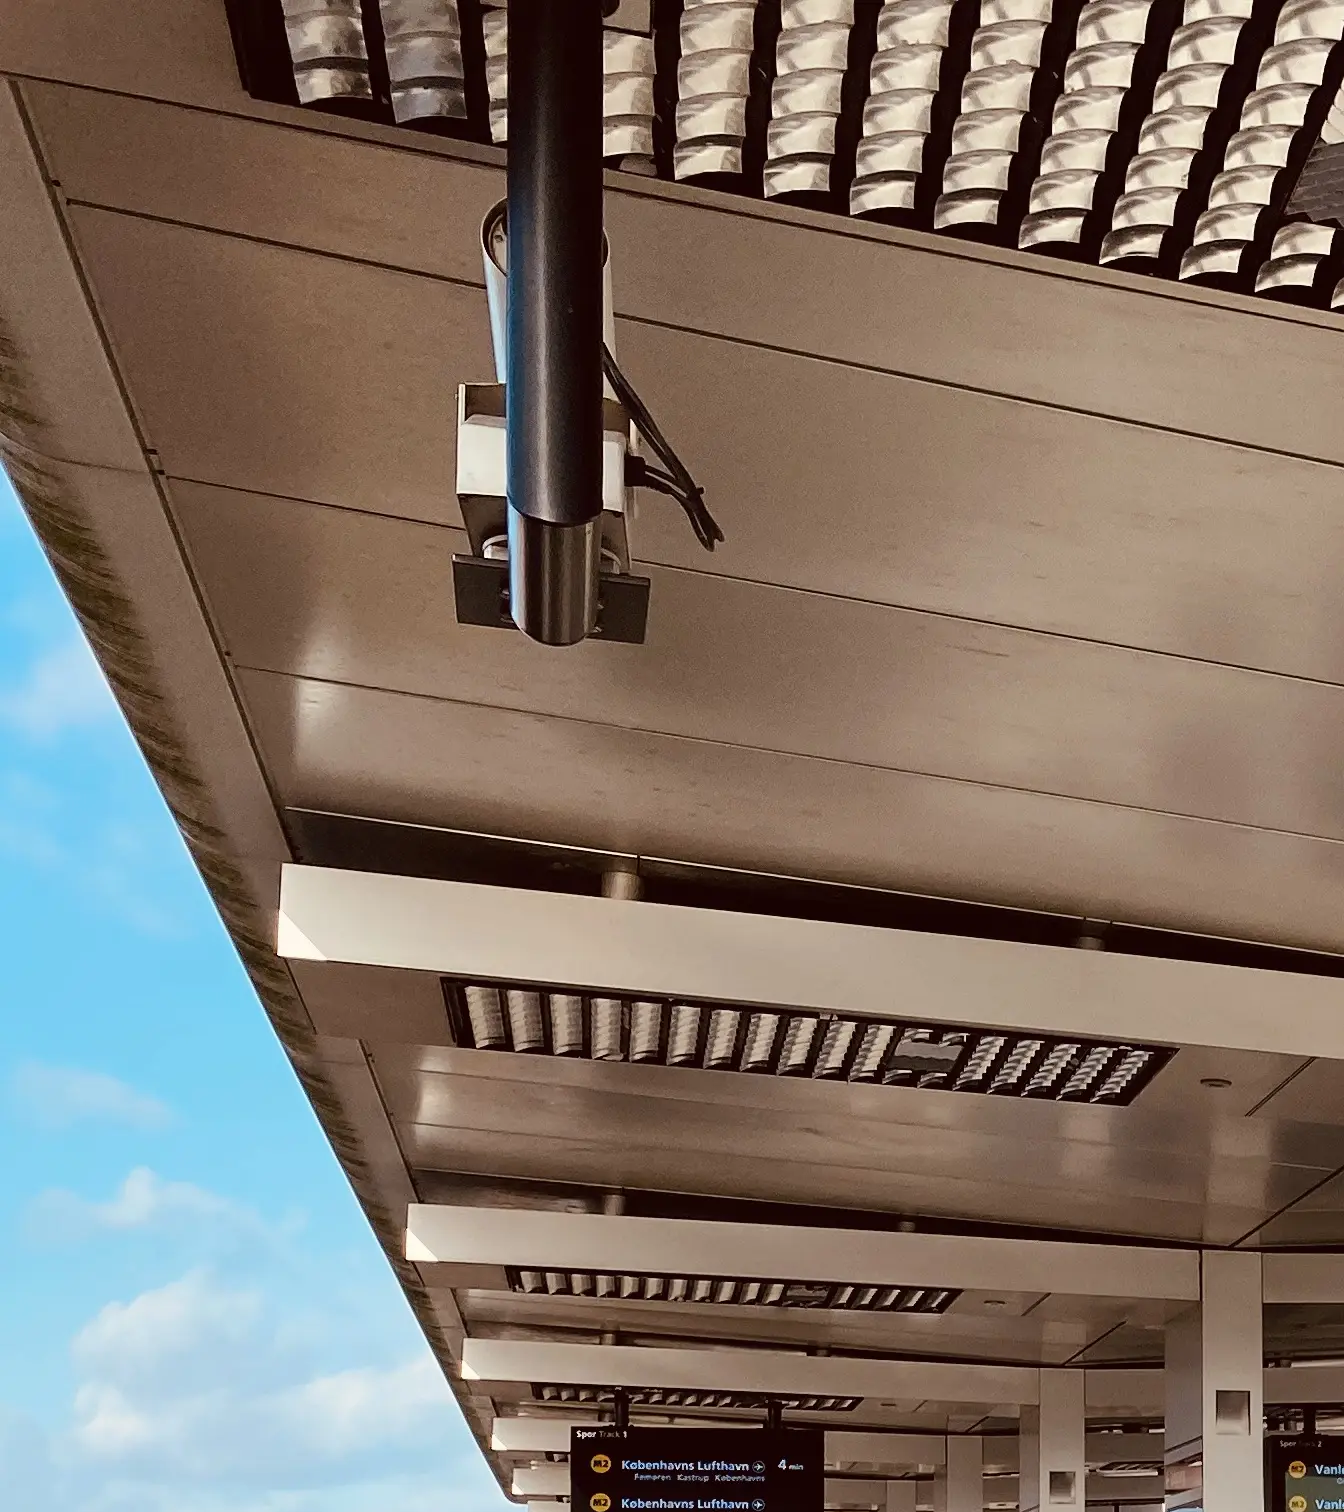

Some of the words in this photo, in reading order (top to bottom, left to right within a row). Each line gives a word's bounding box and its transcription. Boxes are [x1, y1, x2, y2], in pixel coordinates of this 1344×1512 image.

[576, 1430, 597, 1439] Spor
[599, 1430, 620, 1438] Track
[621, 1460, 695, 1471] Københavns
[697, 1461, 750, 1471] Lufthavn
[778, 1459, 787, 1470] 4
[592, 1498, 609, 1507] M2
[621, 1498, 695, 1509] Københavns
[697, 1498, 749, 1510] Lufthavn
